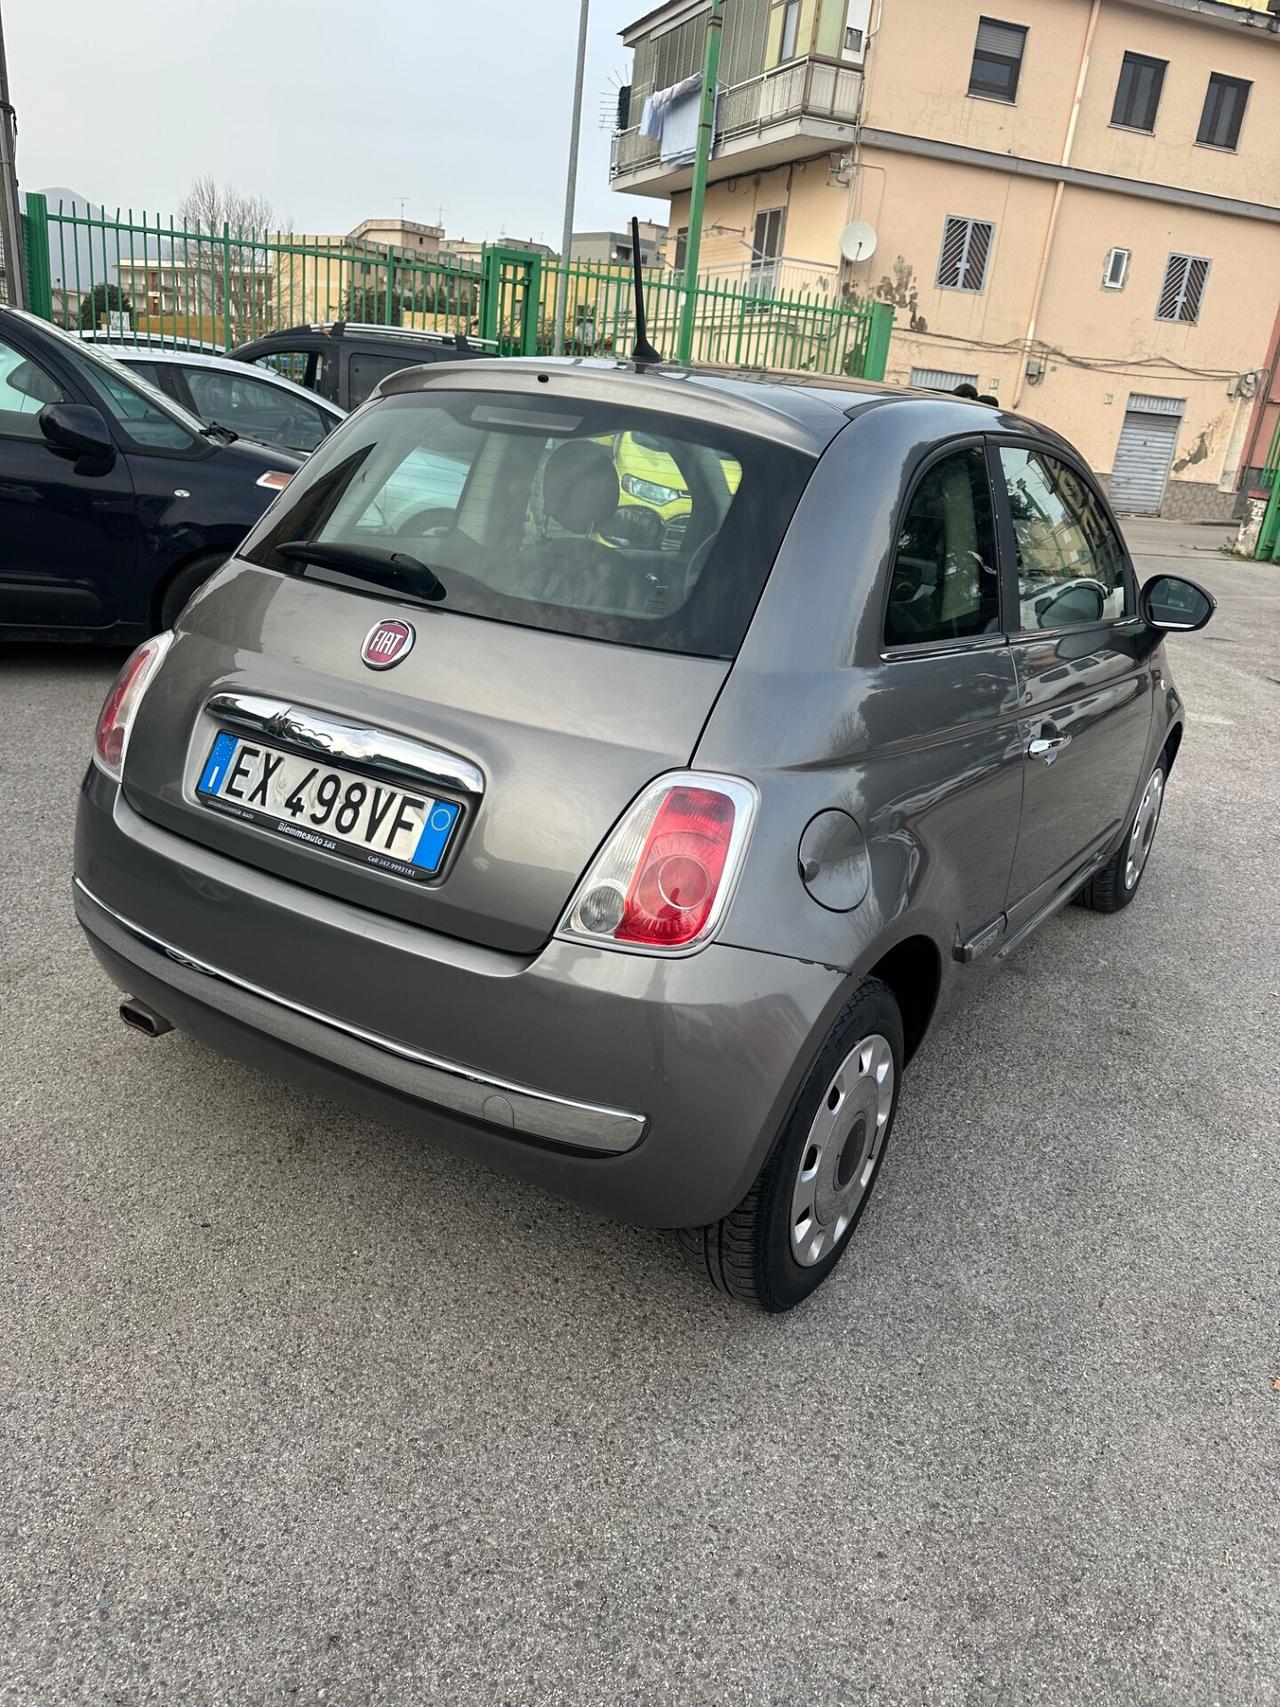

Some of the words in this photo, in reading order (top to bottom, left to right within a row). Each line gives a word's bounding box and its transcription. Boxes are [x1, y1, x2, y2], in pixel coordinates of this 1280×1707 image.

[369, 629, 405, 656] FIAT
[225, 745, 285, 807] EX
[284, 767, 426, 850] 498VF
[277, 822, 323, 845] Biemmeauto
[322, 840, 337, 850] sas
